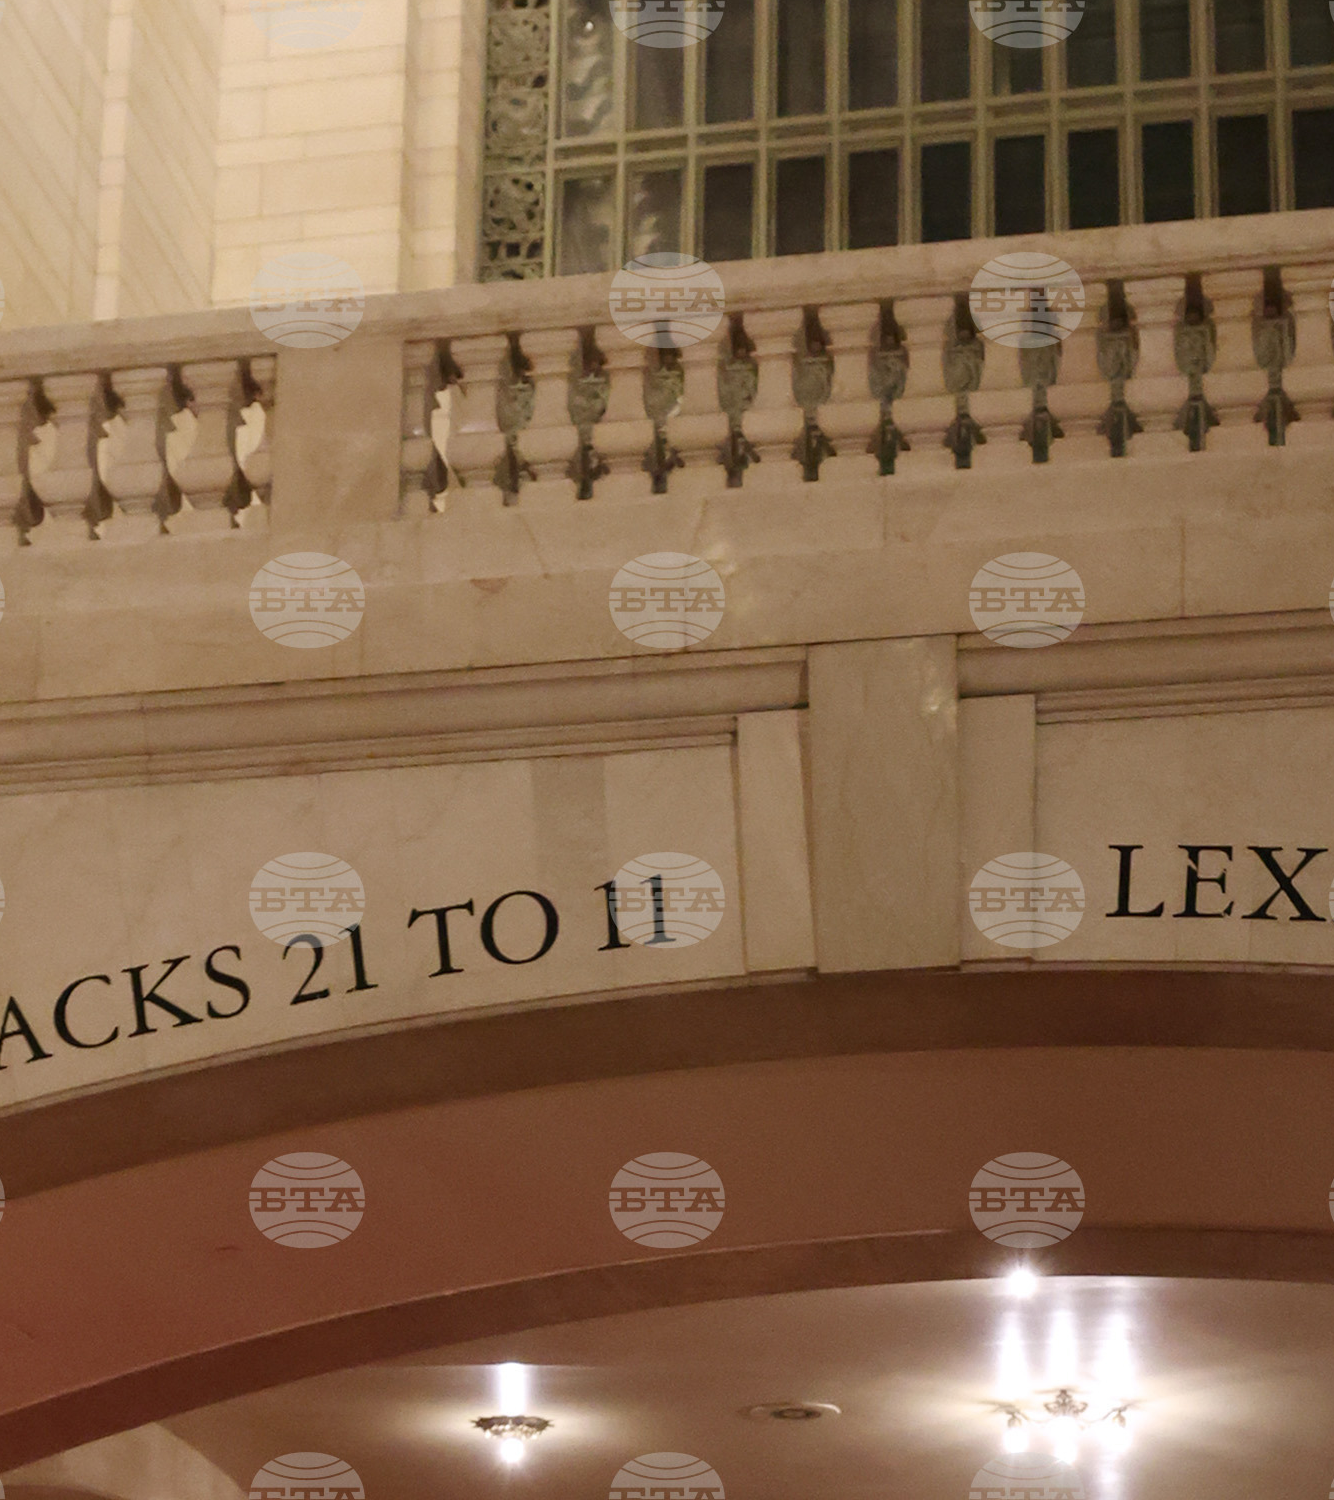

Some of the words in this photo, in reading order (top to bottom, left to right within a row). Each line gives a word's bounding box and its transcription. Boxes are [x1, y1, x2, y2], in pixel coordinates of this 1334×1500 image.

[281, 922, 379, 1006] 21
[407, 889, 560, 979] TO
[593, 873, 677, 952] 11
